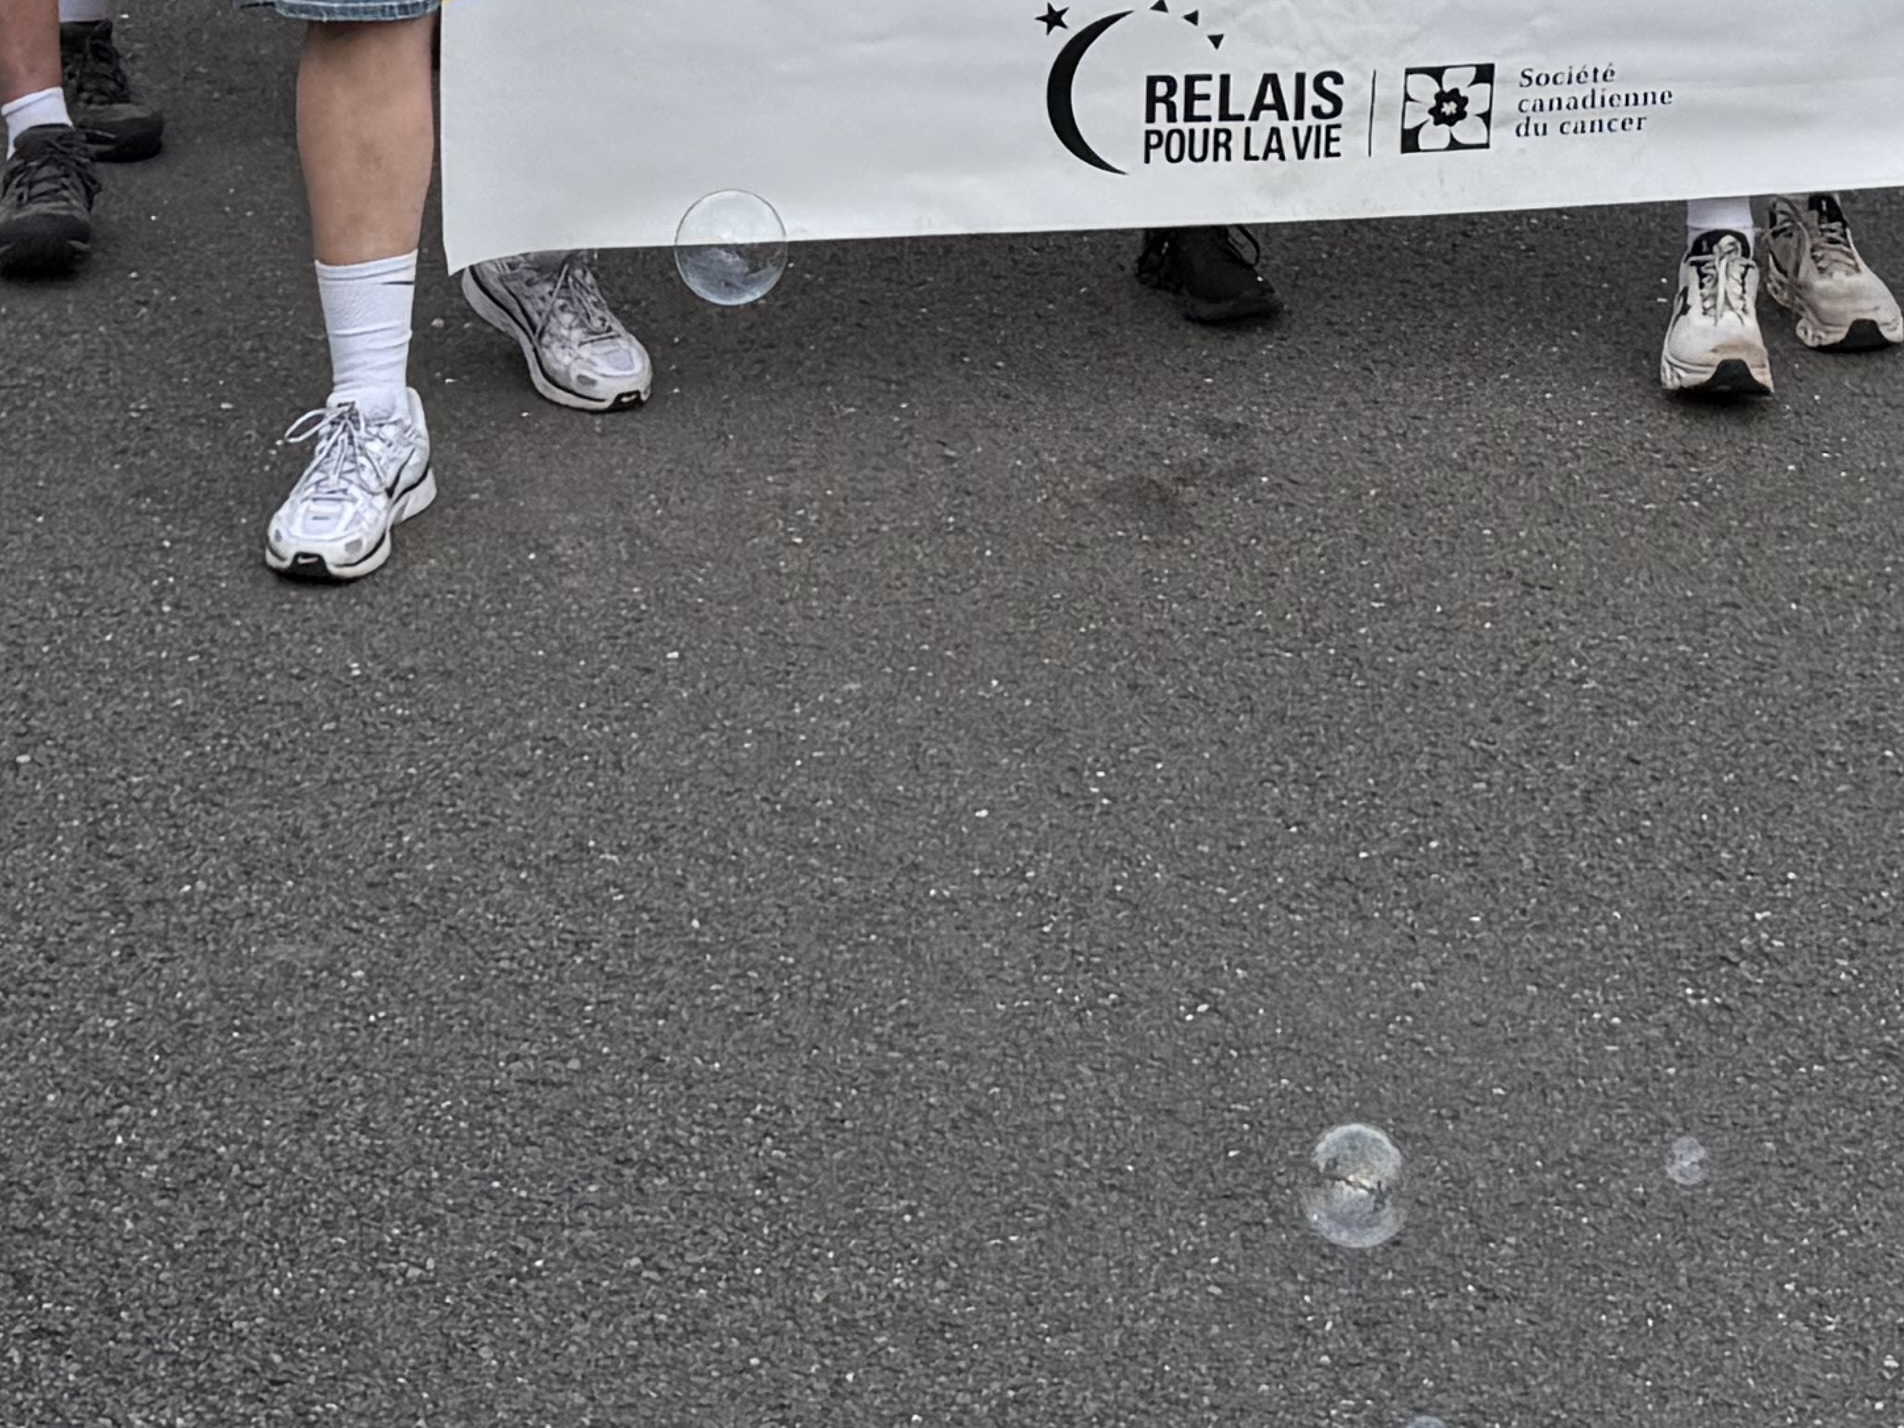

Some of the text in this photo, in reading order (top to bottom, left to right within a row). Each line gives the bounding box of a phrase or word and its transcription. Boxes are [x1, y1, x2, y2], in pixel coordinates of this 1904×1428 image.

[1144, 63, 1617, 124] RELAIS Société
[1517, 88, 1674, 114] canadienne
[1143, 127, 1233, 165] POUR
[1515, 114, 1549, 138] du
[1559, 112, 1648, 137] cancer
